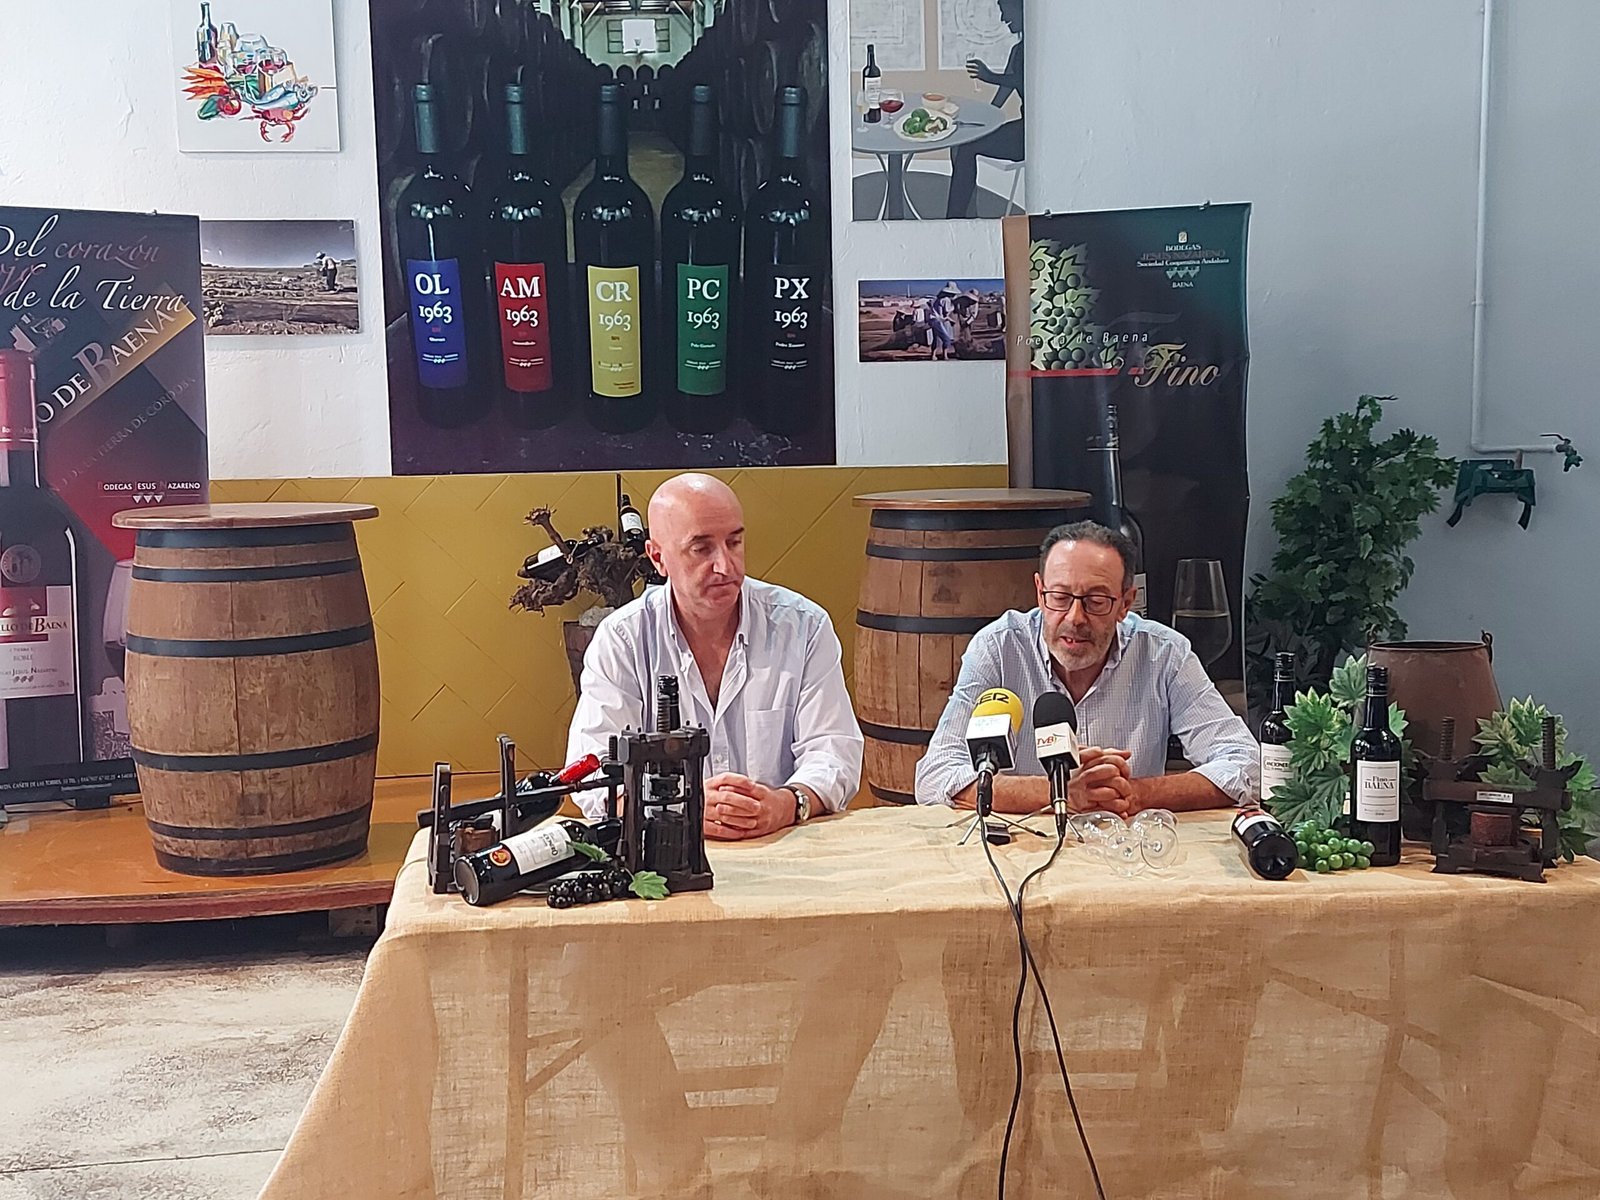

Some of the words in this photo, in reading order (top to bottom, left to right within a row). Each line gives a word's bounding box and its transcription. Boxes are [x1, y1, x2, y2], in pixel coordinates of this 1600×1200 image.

[0, 214, 59, 257] Del
[55, 235, 160, 270] corazón
[1165, 244, 1201, 252] BODEGAS
[3, 263, 47, 311] de
[49, 265, 86, 310] la
[95, 275, 189, 312] Tierra
[414, 273, 450, 296] OL
[500, 276, 541, 298] AM
[595, 281, 632, 303] CR
[687, 277, 720, 300] PC
[774, 277, 811, 300] PX
[418, 301, 453, 324] 1963
[506, 304, 539, 328] 1963
[598, 309, 632, 331] 1963
[687, 307, 720, 330] 1963
[774, 306, 808, 329] 1963
[1076, 333, 1092, 344] de
[1102, 332, 1149, 344] Baena
[51, 373, 92, 410] DE
[72, 308, 176, 391] BAENA
[1134, 343, 1221, 388] Fino
[34, 617, 68, 633] BAENA
[976, 692, 1009, 706] ER
[1364, 781, 1394, 789] BAENA
